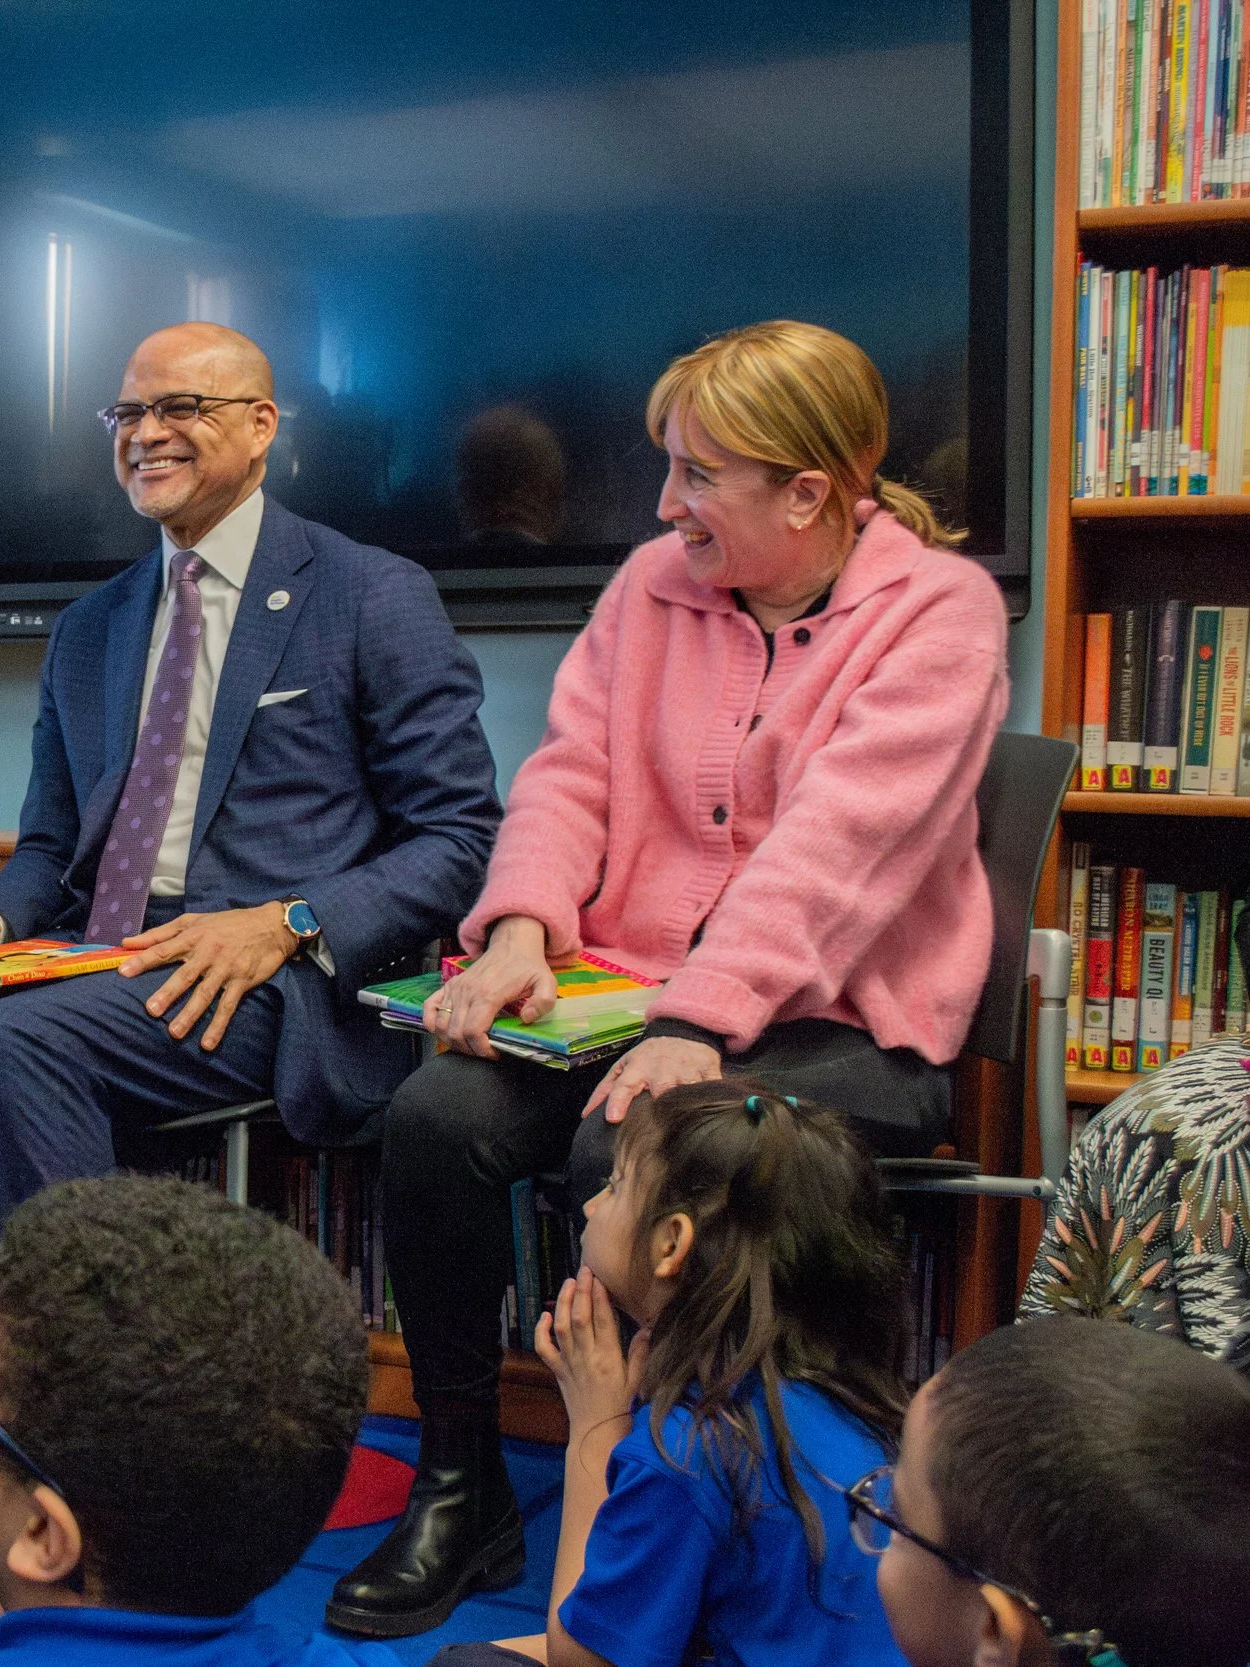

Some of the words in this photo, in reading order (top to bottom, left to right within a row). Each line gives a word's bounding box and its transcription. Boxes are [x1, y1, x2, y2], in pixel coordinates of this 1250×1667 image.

[1223, 656, 1238, 680] LIONS
[1222, 688, 1238, 712] LITTLE
[1219, 715, 1234, 736] ROCK
[1118, 768, 1131, 783] A
[1148, 938, 1166, 984] BEAUTY
[31, 970, 46, 980] Diao
[1090, 1046, 1103, 1063] A
[1146, 1046, 1158, 1064] A
